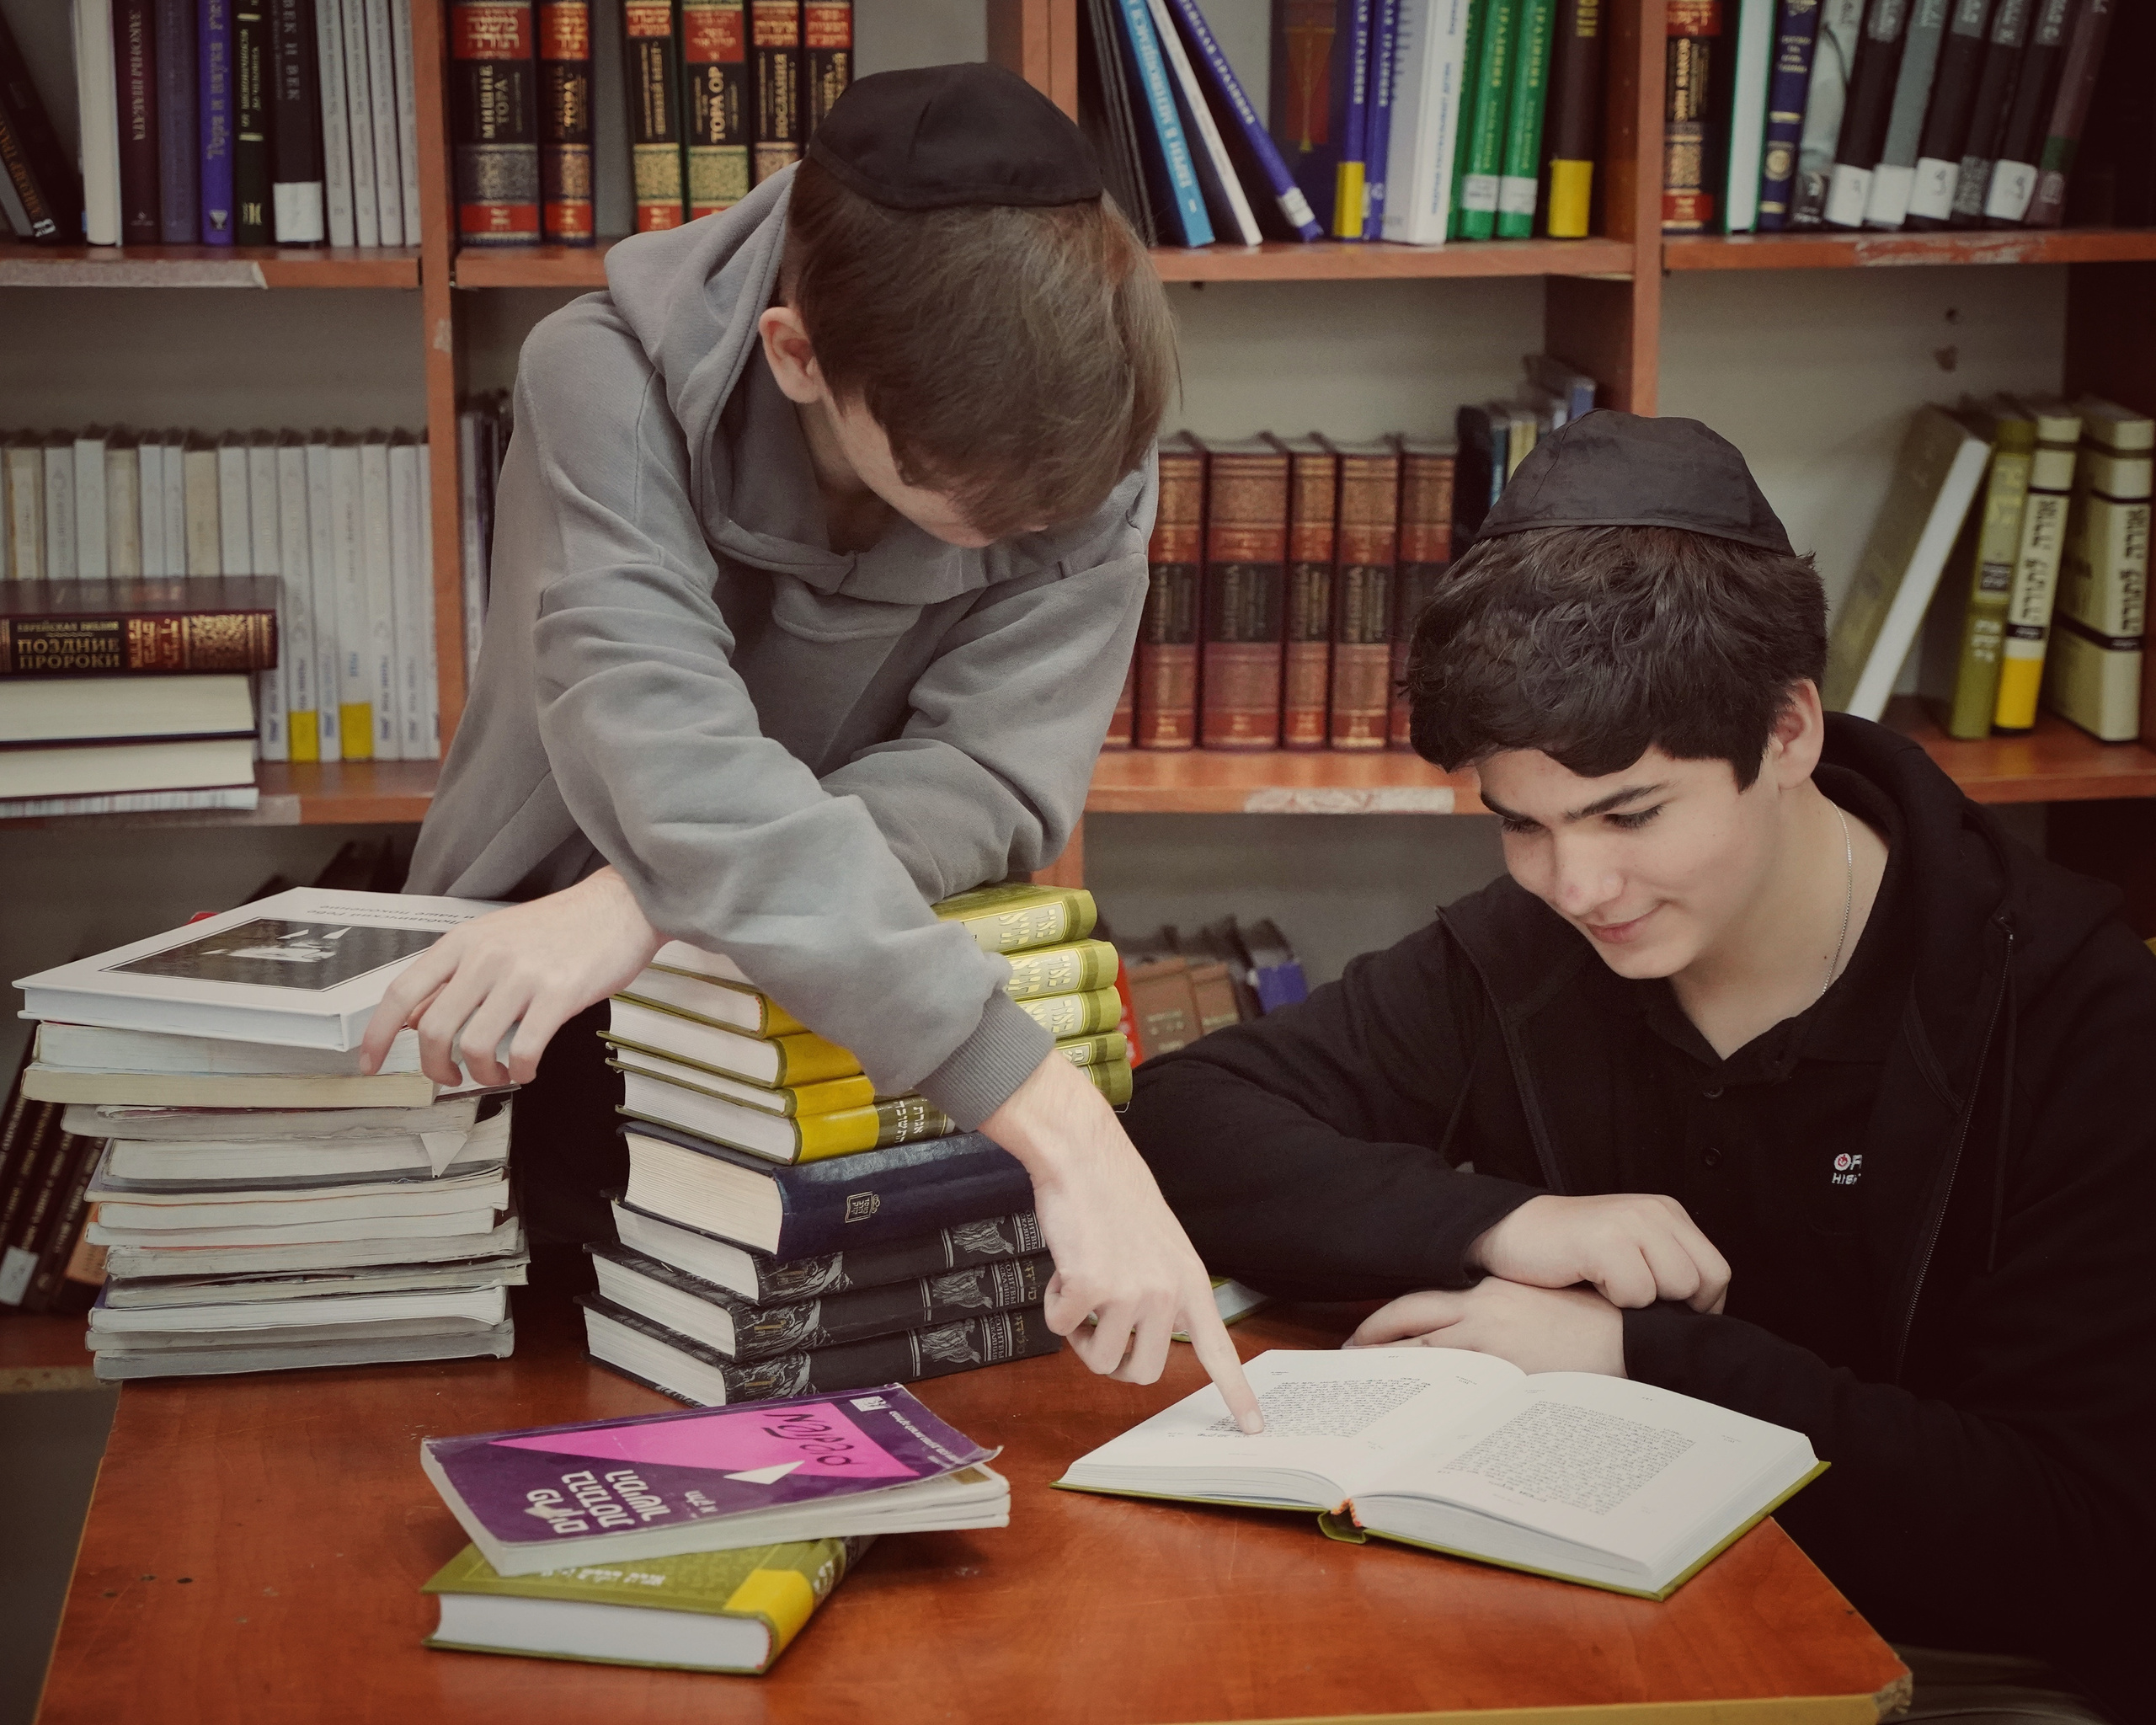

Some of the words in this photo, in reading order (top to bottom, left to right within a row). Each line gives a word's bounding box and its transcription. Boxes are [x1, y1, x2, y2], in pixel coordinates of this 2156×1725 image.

[207, 41, 228, 93] наука
[707, 66, 724, 93] ОР
[494, 78, 510, 126] ТОРА
[563, 78, 579, 127] ТОРА
[709, 94, 727, 143] ТОРА
[203, 115, 228, 159] Тора
[17, 638, 121, 654] ПОЗДНИЕ
[19, 653, 120, 670] ПРОРОКИ
[306, 909, 347, 917] Ребе
[319, 905, 411, 916] поколение
[894, 1100, 909, 1143] התשובה
[912, 1106, 926, 1135] אגרת
[1020, 1213, 1032, 1252] СКАЯНИЯ
[1025, 1210, 1038, 1250] ОЛИТВЫ
[989, 1316, 998, 1360] АСКАЯНИЯ
[561, 1470, 635, 1528] בהנדסת
[605, 1469, 671, 1522] המישור
